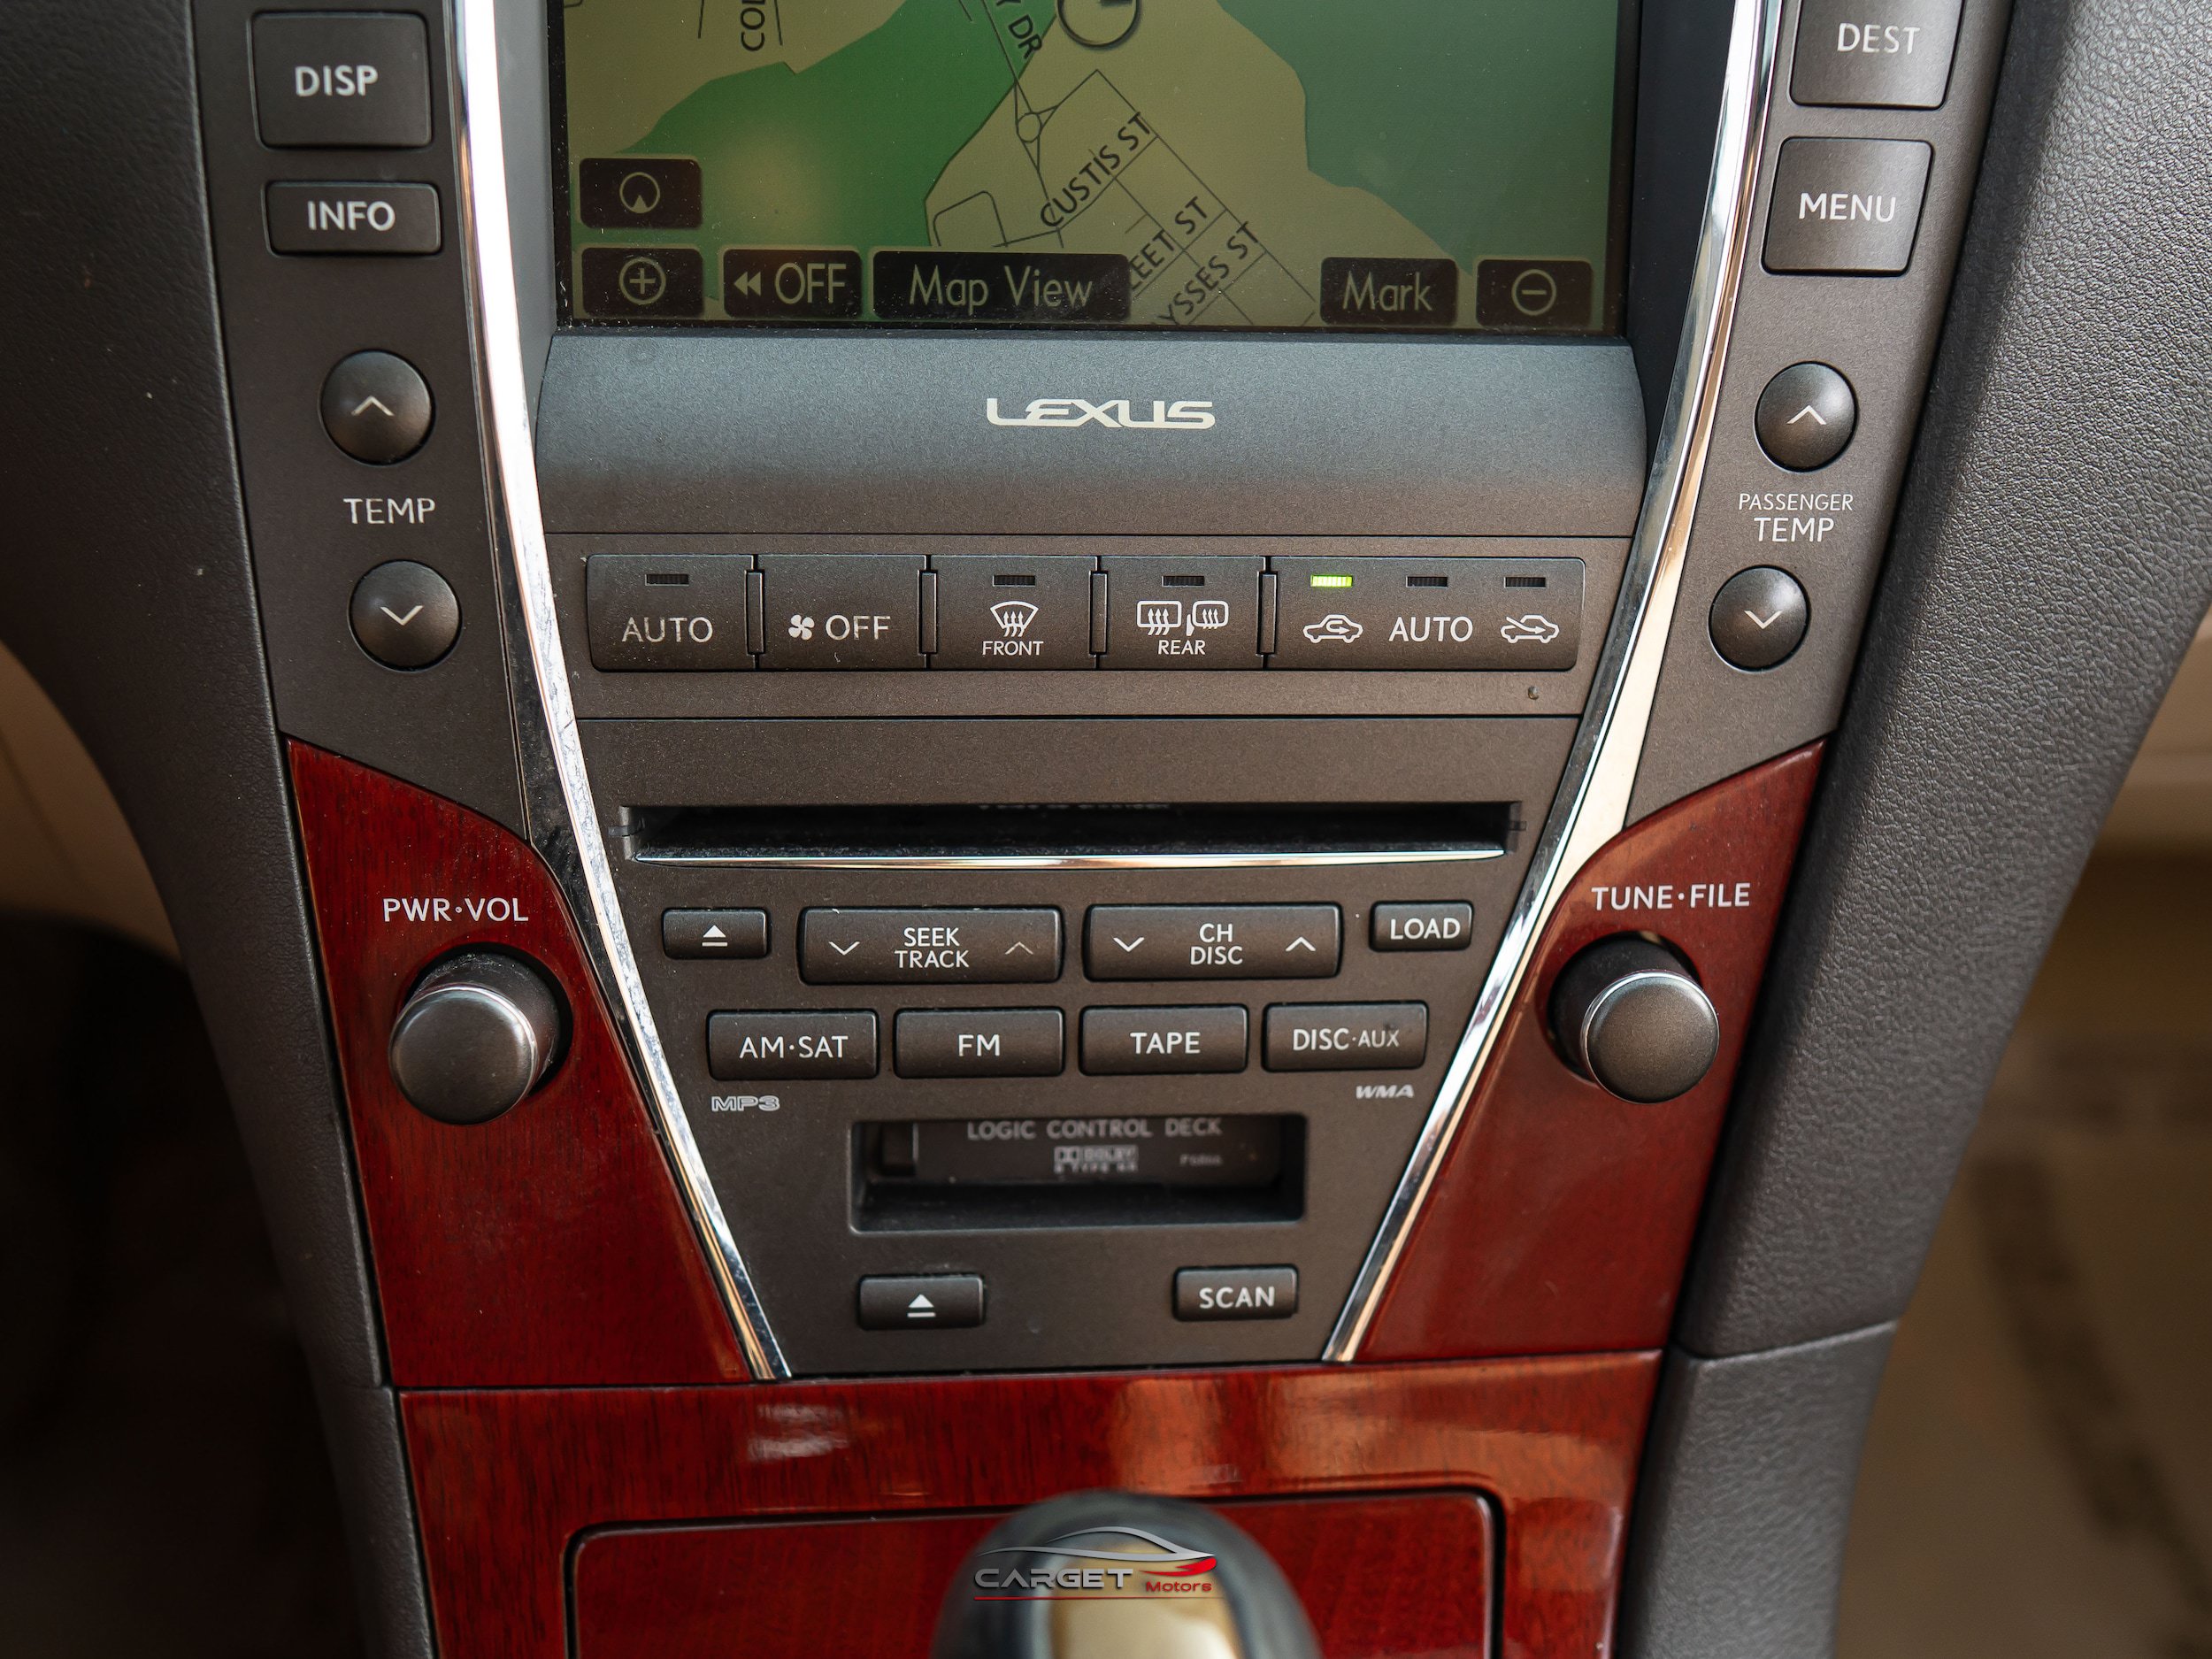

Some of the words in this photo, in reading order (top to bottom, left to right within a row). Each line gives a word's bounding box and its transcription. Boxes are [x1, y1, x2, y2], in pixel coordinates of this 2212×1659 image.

[741, 0, 765, 51] CO
[1009, 14, 1042, 59] DR
[1837, 22, 1921, 55] DEST
[295, 65, 379, 97] DISP
[1040, 144, 1121, 227] CUSTIS
[1117, 111, 1150, 151] ST
[307, 201, 396, 231] INFO
[1174, 196, 1208, 235] ST
[1798, 192, 1896, 222] MENU
[1226, 220, 1259, 260] ST
[774, 262, 847, 304] OFF
[909, 264, 988, 316] Map
[1003, 265, 1094, 308] View
[1341, 270, 1432, 312] Mark
[987, 397, 1216, 430] LEXUS
[342, 497, 436, 525] TEMP
[1738, 493, 1854, 511] PASSENGER
[1754, 517, 1835, 542] TEMP
[621, 617, 714, 643] AUTO
[825, 614, 891, 641] OFF
[1388, 617, 1473, 642] AUTO
[982, 640, 1044, 657] FRONT
[1157, 640, 1207, 656] REAR
[903, 927, 960, 948] SEEK
[1199, 923, 1233, 943] CH
[1389, 918, 1462, 941] LOAD
[894, 949, 970, 969] TRACK
[1189, 946, 1244, 965] DISC
[958, 1033, 1001, 1056] FM
[1129, 1032, 1202, 1055] TAPE
[710, 1095, 780, 1112] MP3
[1356, 1084, 1415, 1100] WMA
[967, 1120, 1036, 1141] LOGIC
[1046, 1118, 1154, 1139] CONTROL
[1164, 1117, 1223, 1137] DECK
[1198, 1286, 1275, 1310] SCAN
